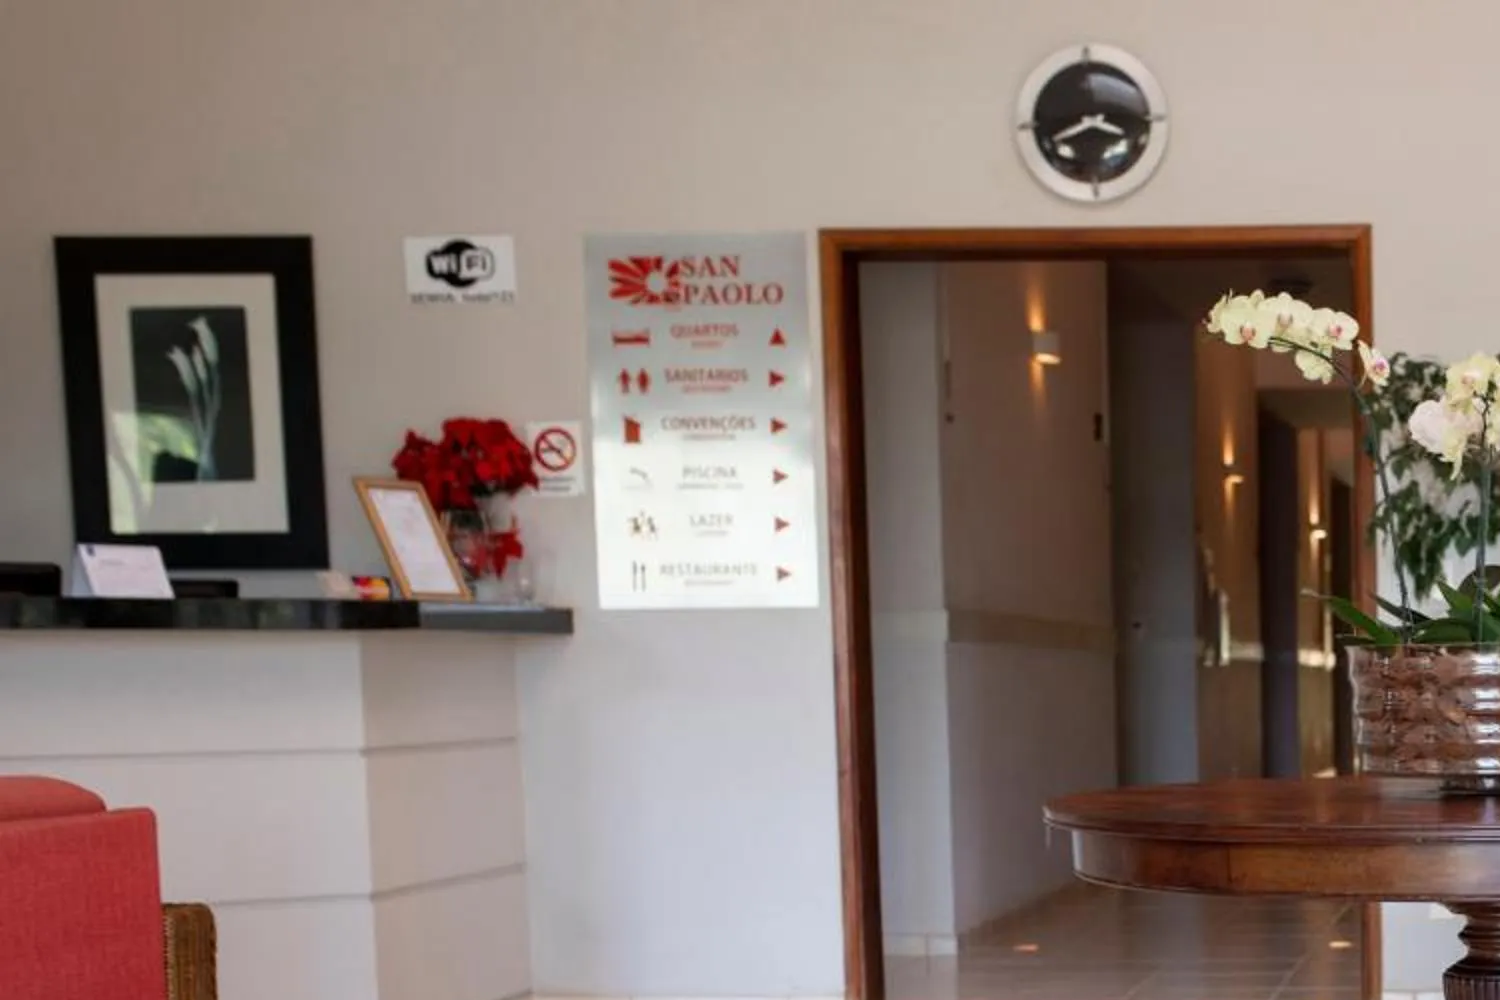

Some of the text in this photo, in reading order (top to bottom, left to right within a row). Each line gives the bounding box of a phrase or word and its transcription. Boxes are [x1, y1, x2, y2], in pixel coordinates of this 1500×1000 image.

[681, 255, 740, 277] SAN
[683, 282, 784, 305] PAOLO
[670, 323, 739, 339] QUARTOS
[682, 466, 737, 479] PISCINA
[689, 513, 734, 527] LAZER
[660, 563, 758, 576] RESTAURANTE
